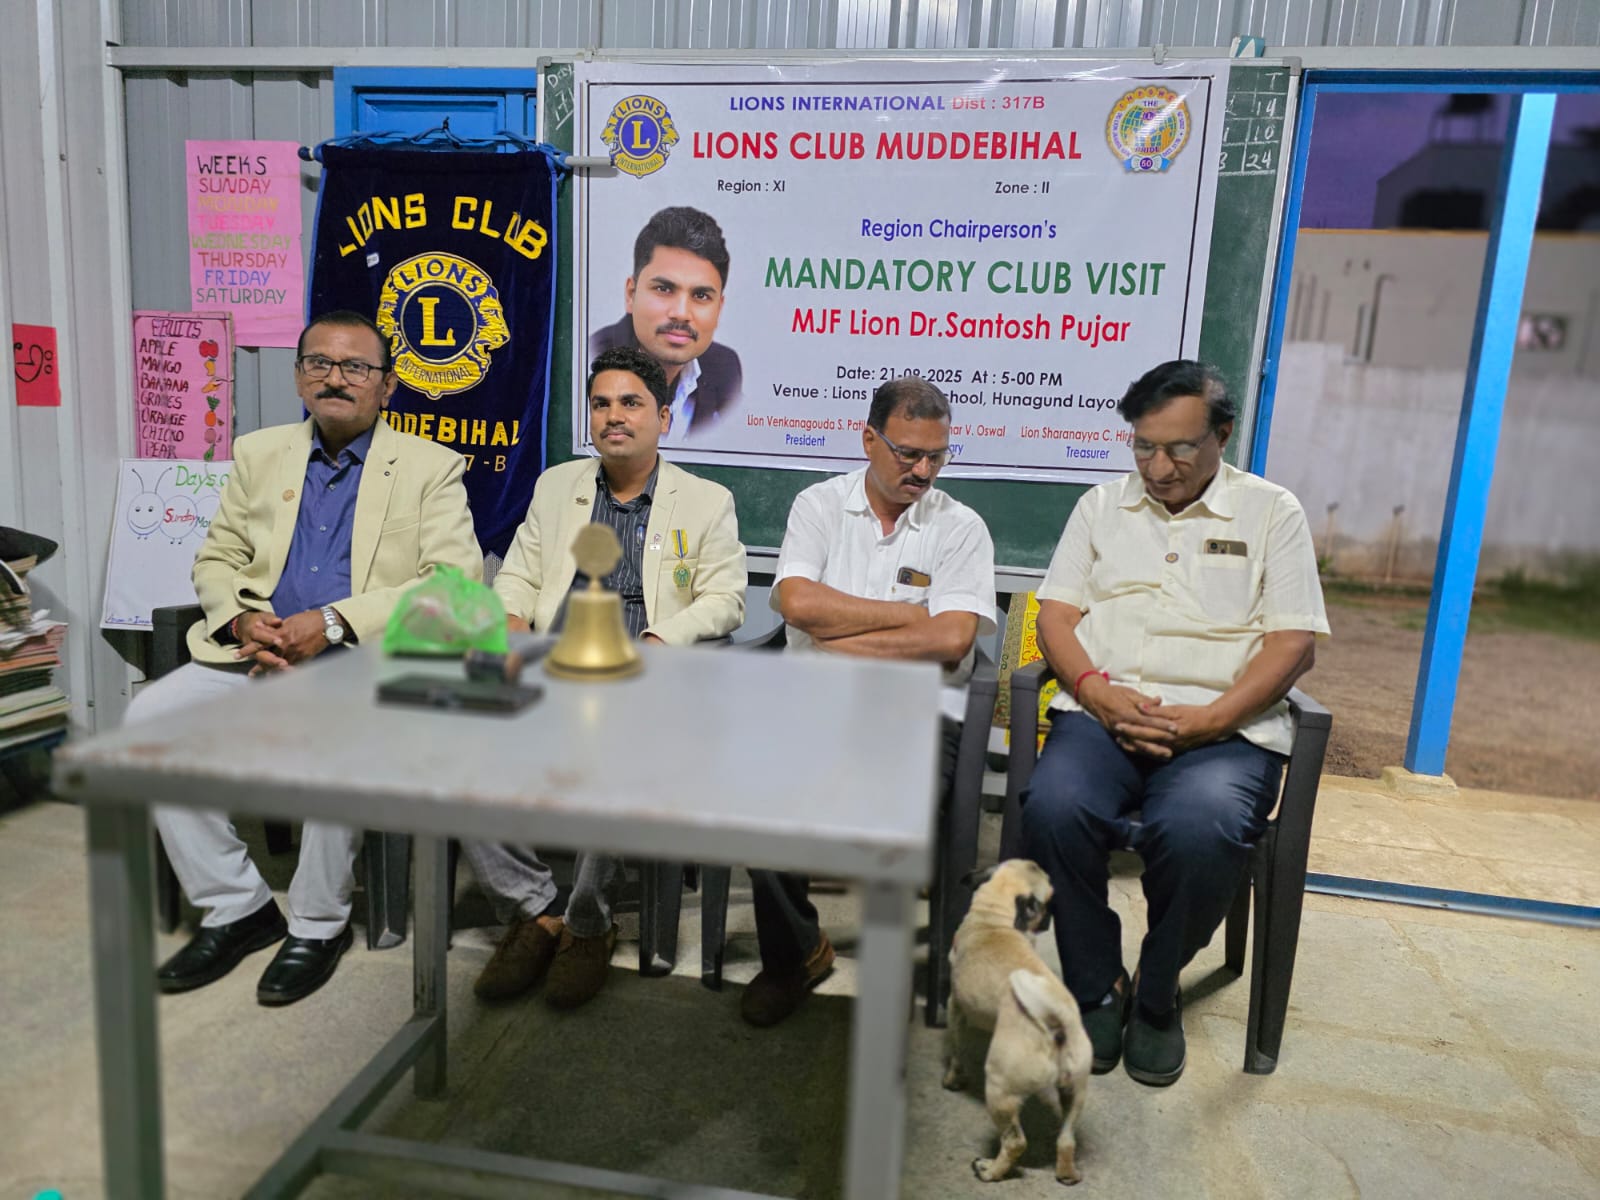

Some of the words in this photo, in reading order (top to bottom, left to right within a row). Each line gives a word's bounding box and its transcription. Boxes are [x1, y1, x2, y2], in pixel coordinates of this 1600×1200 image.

[618, 98, 663, 116] LIONS
[730, 96, 785, 111] LIONS
[792, 95, 945, 111] INTERNATIONAL
[952, 95, 986, 110] Dist
[1001, 95, 1045, 110] 317B
[1256, 98, 1277, 117] 14
[631, 120, 651, 149] L
[693, 131, 778, 159] LIONS
[790, 131, 865, 160] CLUB
[875, 131, 1082, 160] MUDDEBIHAL
[197, 155, 267, 175] WEEKS
[1246, 149, 1272, 170] 24
[199, 178, 271, 194] SUNDAY
[717, 179, 761, 194] Region
[773, 180, 785, 192] XI
[995, 181, 1029, 194] Zone
[1041, 181, 1050, 194] II
[197, 214, 275, 230] TUESDAY
[338, 193, 427, 257] LIONS
[451, 196, 548, 259] CLUB
[861, 218, 923, 241] Region
[929, 219, 1057, 242] Chairperson's
[191, 233, 292, 249] WEDNESDAY
[198, 252, 288, 268] THURSDAY
[205, 269, 271, 286] FRIDAY
[401, 258, 483, 294] LIONS
[764, 256, 976, 292] MANDATORY
[987, 260, 1072, 294] CLUB
[1085, 261, 1166, 296] VISIT
[196, 288, 287, 304] SATURDAY
[151, 319, 203, 339] FRUITS
[418, 297, 456, 346] L
[791, 308, 841, 334] MJF
[849, 309, 900, 336] Lion
[909, 310, 1050, 340] Dr.Santosh
[1061, 315, 1131, 348] Pujar
[139, 338, 178, 356] APPLE
[140, 356, 182, 374] MANGO
[400, 357, 474, 385] INTERNATIONAL
[140, 373, 189, 392] BANANA
[836, 366, 875, 380] Date:
[1001, 371, 1035, 386] 5-00
[1039, 372, 1063, 387] PM
[772, 383, 819, 398] Venue
[832, 386, 867, 400] Lions
[992, 392, 1073, 409] Hunagund
[1078, 394, 1120, 412] Layo
[380, 410, 519, 447] DDEBIHAL
[747, 414, 764, 427] Lion
[767, 415, 835, 432] Venkanagouda
[965, 424, 974, 437] V.
[976, 424, 1006, 437] Oswal
[785, 433, 826, 447] President
[1021, 426, 1040, 439] Lion
[1042, 427, 1099, 443] Sharanayya
[1102, 429, 1112, 441] C.
[145, 441, 178, 459] PEAR
[1066, 446, 1110, 459] Treasurer
